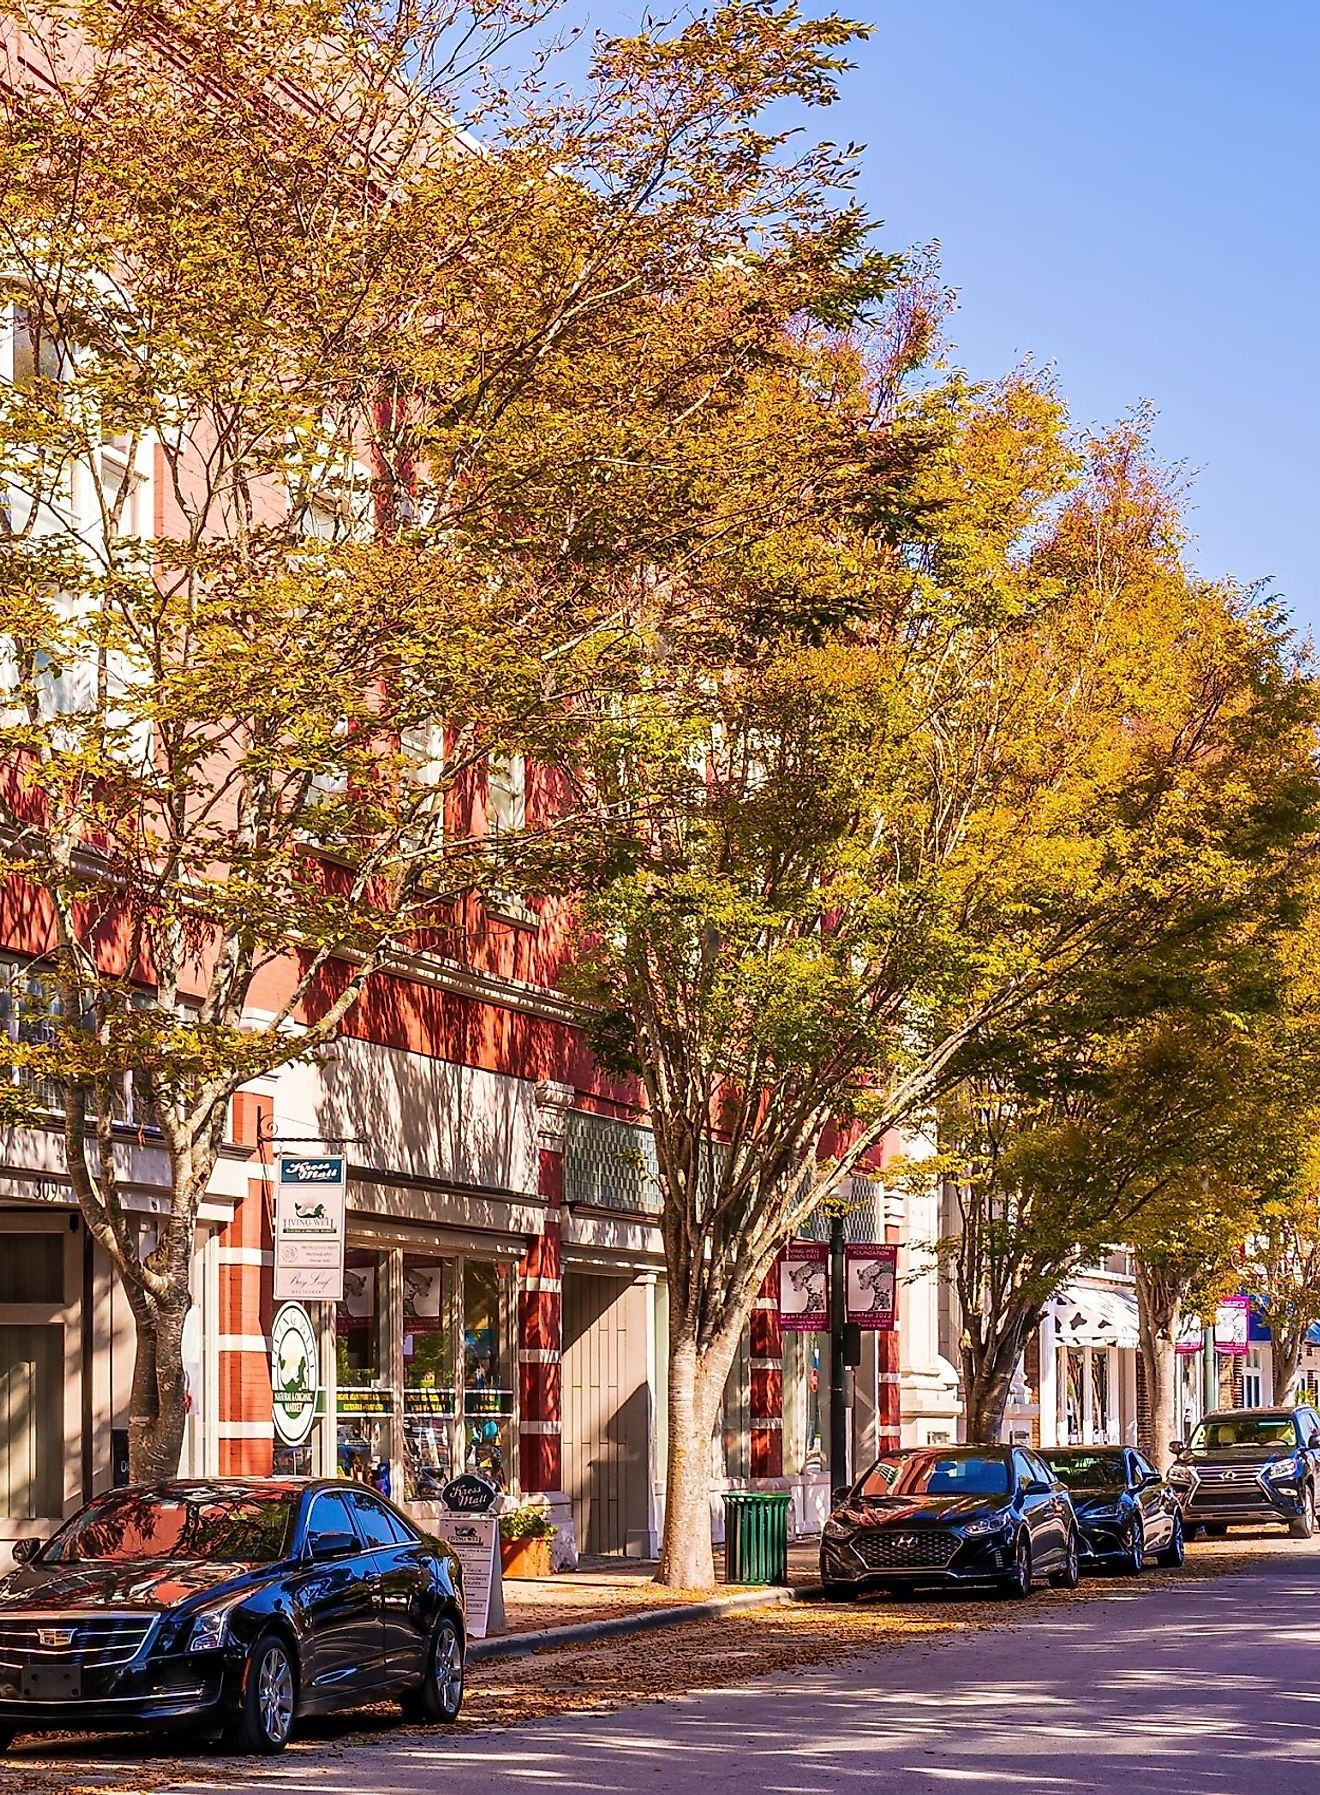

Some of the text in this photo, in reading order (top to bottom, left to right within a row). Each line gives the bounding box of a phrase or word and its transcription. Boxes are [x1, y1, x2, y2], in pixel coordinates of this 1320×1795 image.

[285, 1162, 330, 1174] Kress
[298, 1169, 337, 1180] Mall
[33, 1178, 58, 1202] 309
[450, 1484, 481, 1497] Kress
[458, 1494, 487, 1507] Mall
